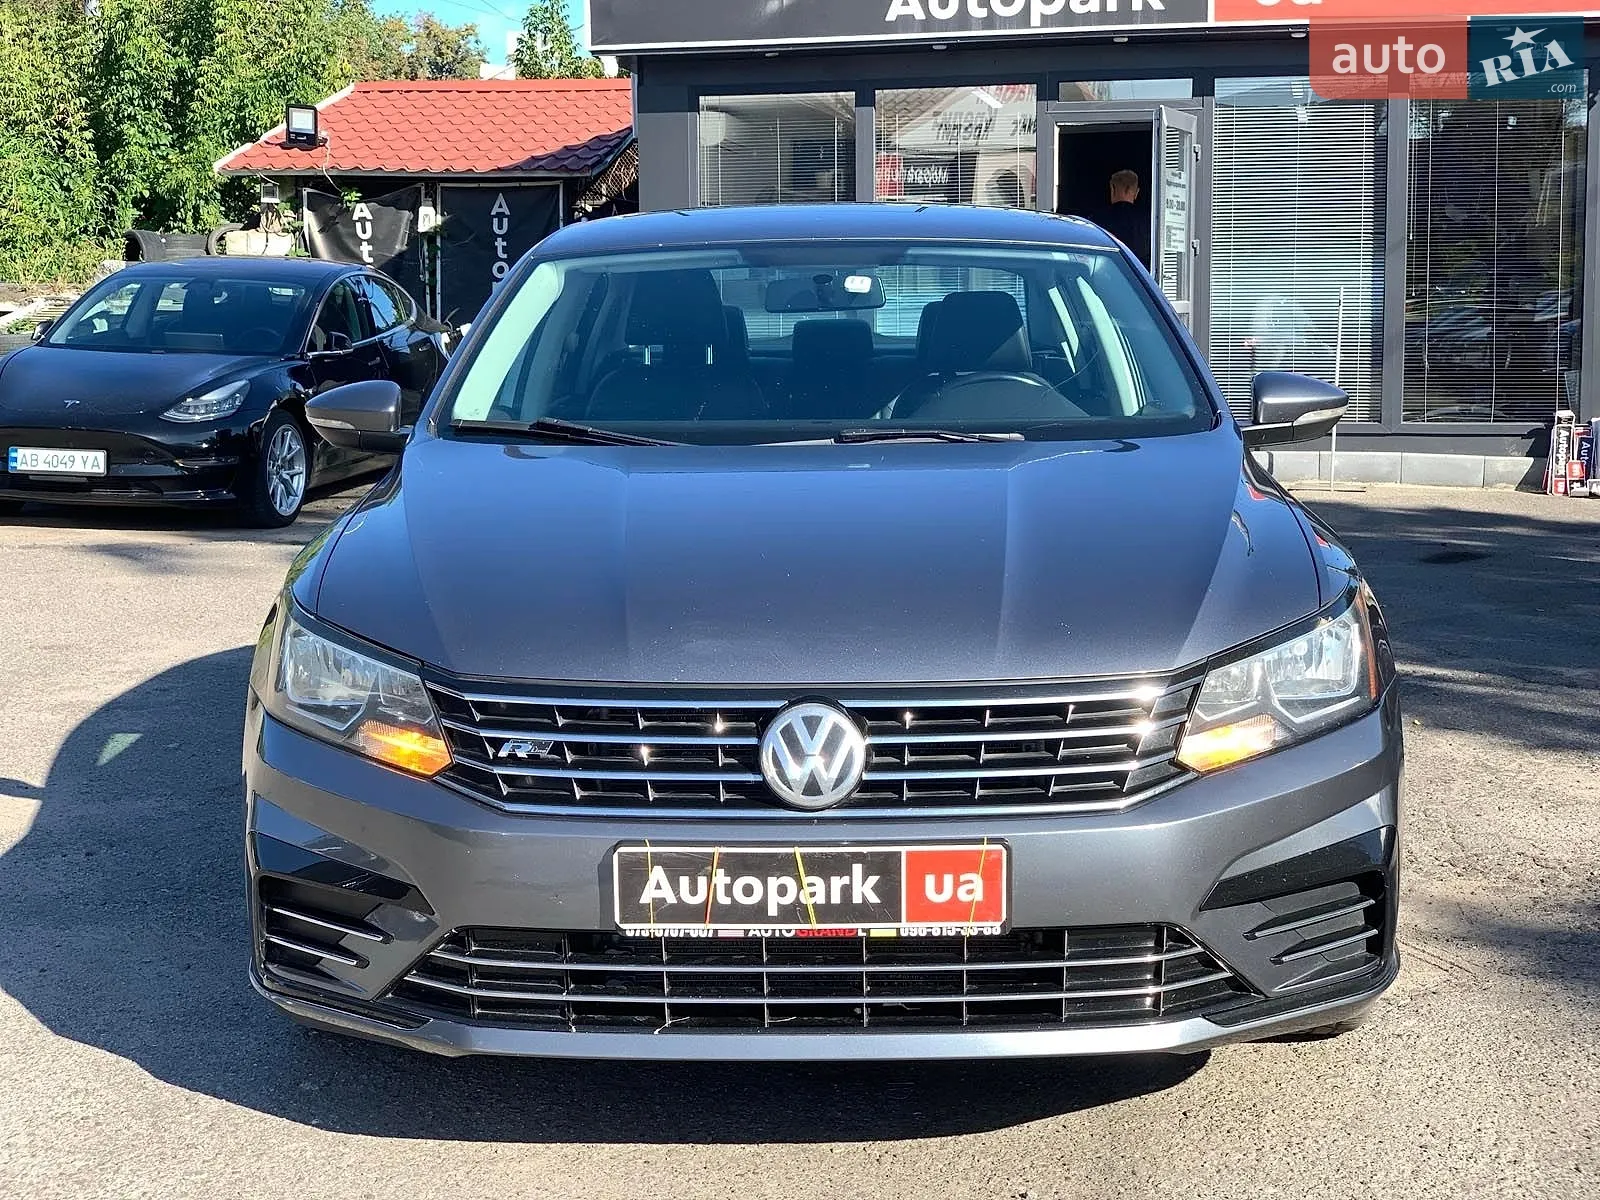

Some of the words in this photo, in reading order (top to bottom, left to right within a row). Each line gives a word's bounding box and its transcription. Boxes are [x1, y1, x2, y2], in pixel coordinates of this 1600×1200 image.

[885, 0, 1165, 27] Autop
[352, 202, 373, 267] Aut
[20, 453, 39, 468] AB
[43, 453, 76, 469] 4049
[81, 455, 101, 470] YA
[639, 863, 881, 917] Autopark
[924, 872, 984, 903] ua
